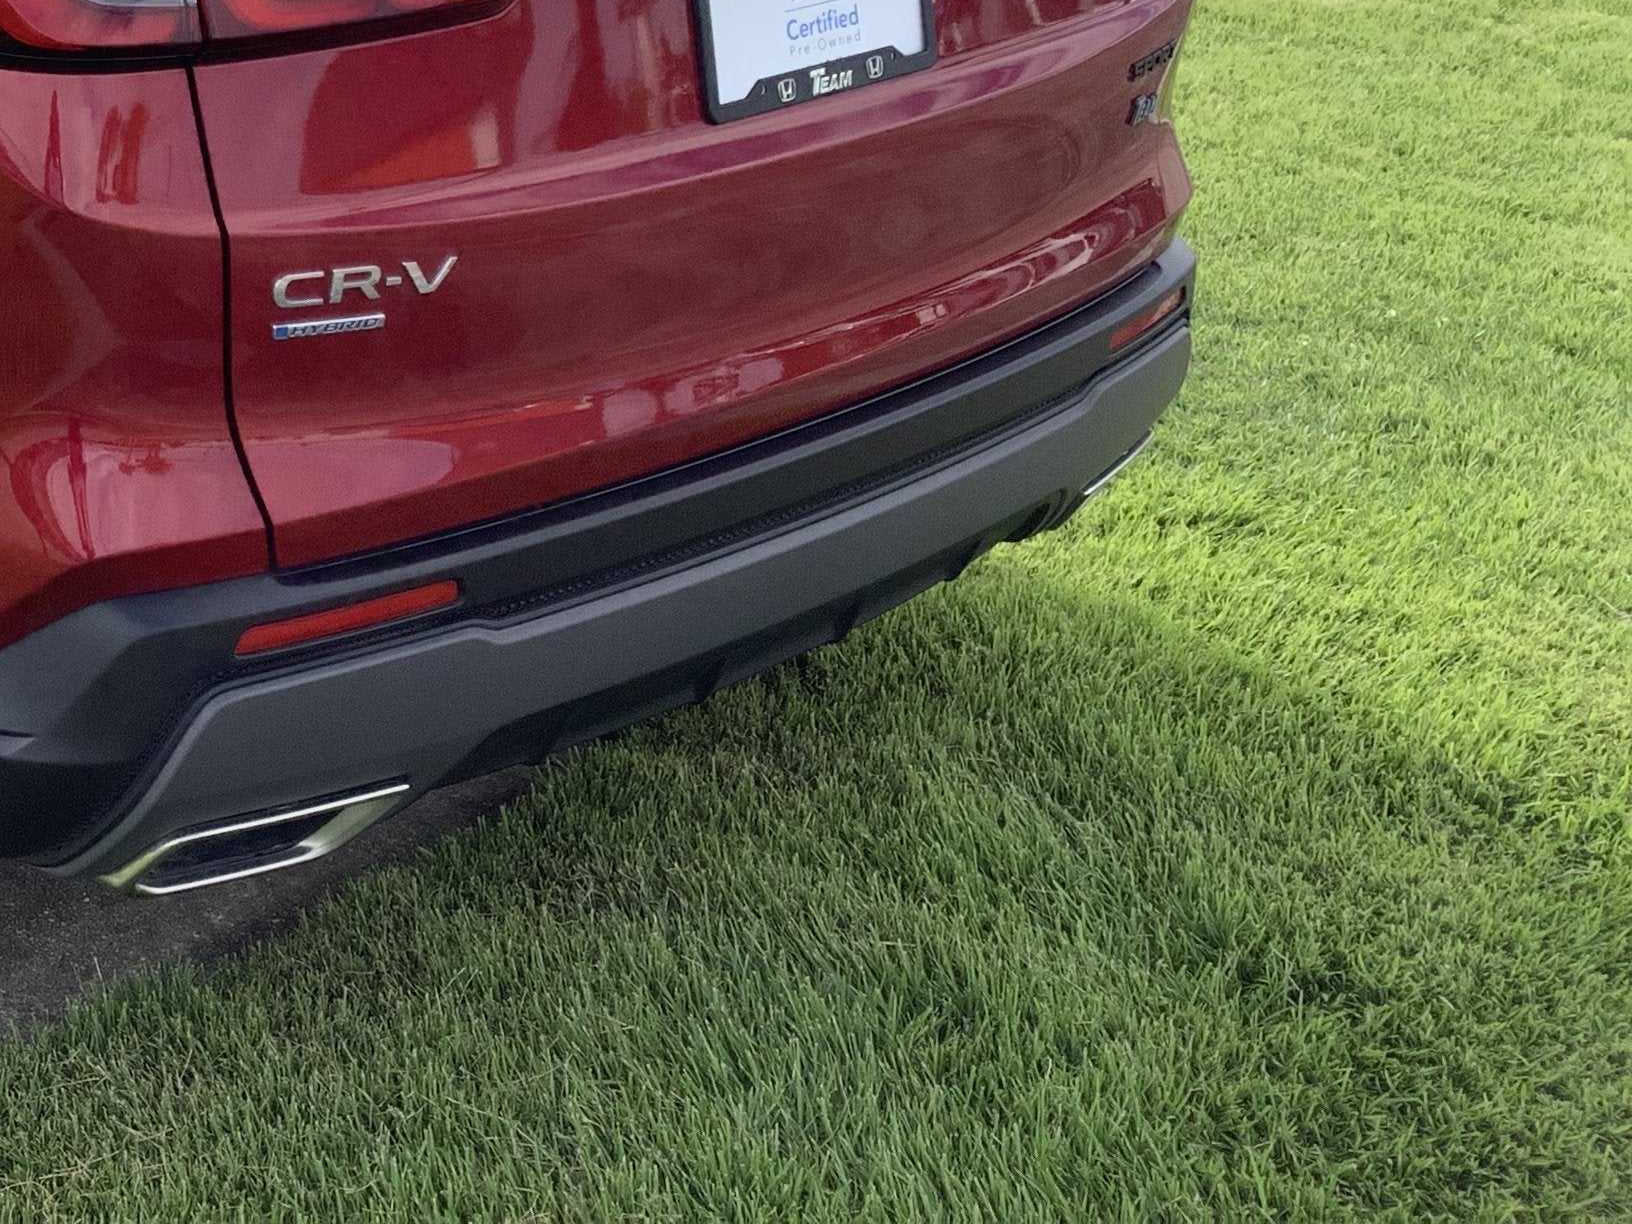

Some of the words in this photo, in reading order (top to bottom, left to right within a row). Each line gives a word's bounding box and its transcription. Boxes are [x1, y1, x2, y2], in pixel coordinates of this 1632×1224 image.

[786, 3, 859, 41] Certified
[788, 28, 861, 58] Pre-Owned
[809, 67, 854, 97] TEAM
[273, 255, 458, 308] CR-V
[291, 317, 380, 336] HYBRID
